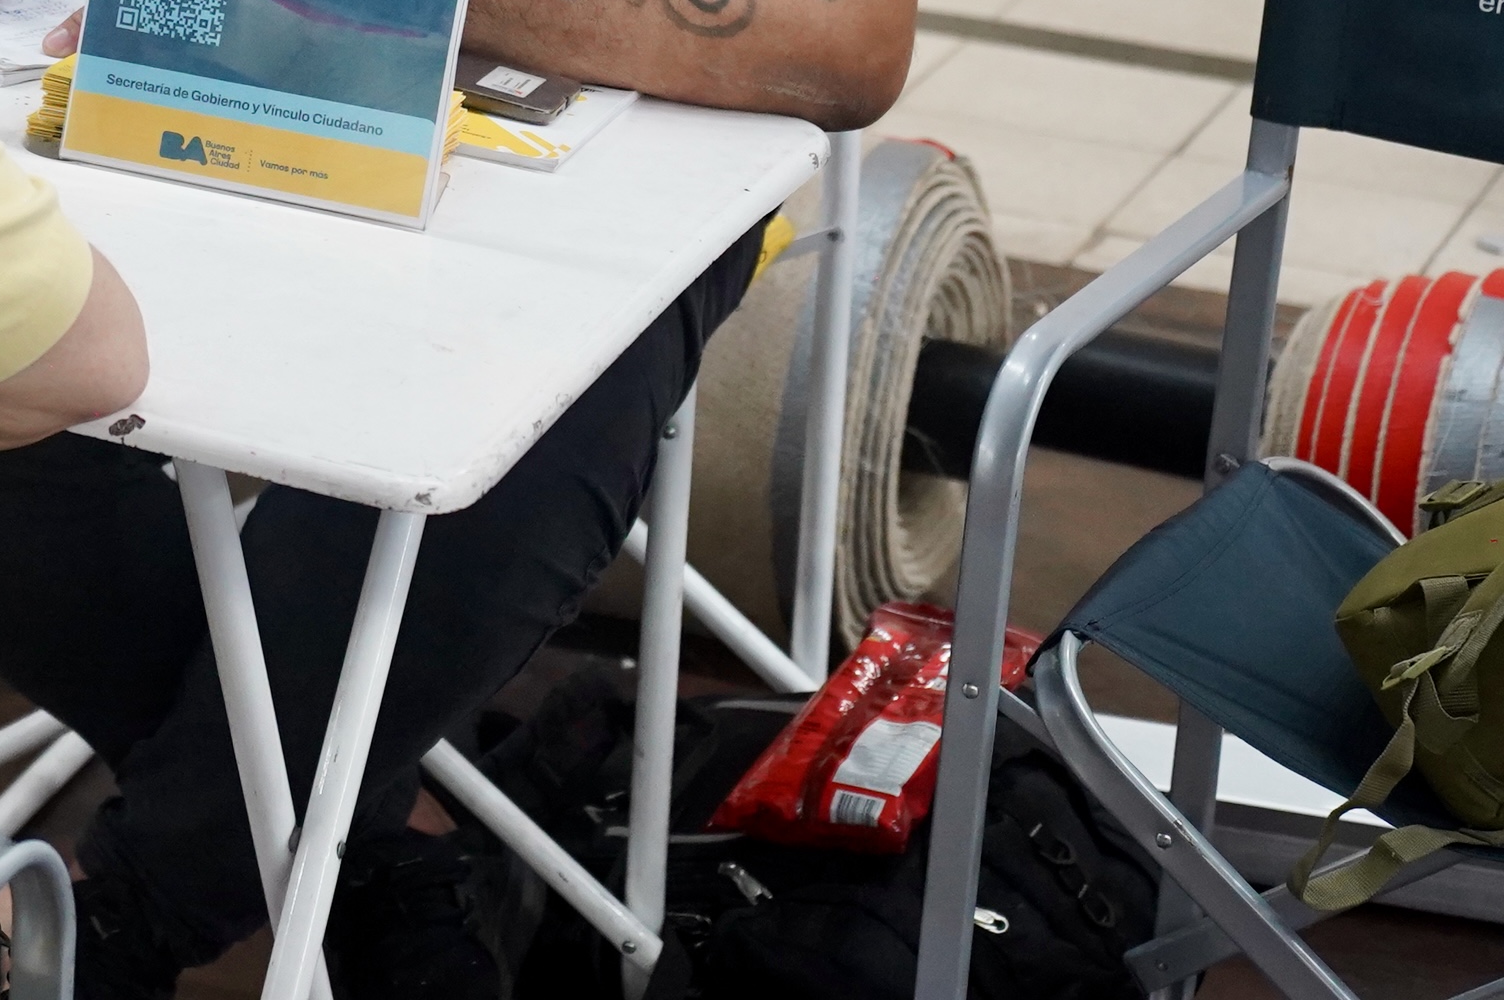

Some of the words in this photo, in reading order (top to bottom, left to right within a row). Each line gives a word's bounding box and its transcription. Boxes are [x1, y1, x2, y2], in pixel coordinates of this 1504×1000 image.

[106, 73, 171, 96] Secretaría
[173, 86, 189, 99] de
[191, 90, 250, 111] Gobierno
[251, 101, 260, 115] y
[262, 102, 310, 122] Vínculo
[312, 112, 383, 137] Ciudadano
[159, 130, 208, 166] BA
[205, 140, 236, 153] Buenos
[209, 149, 232, 161] Aires
[210, 157, 240, 170] Ciudad
[259, 159, 289, 172] Vamos
[290, 166, 308, 176] por
